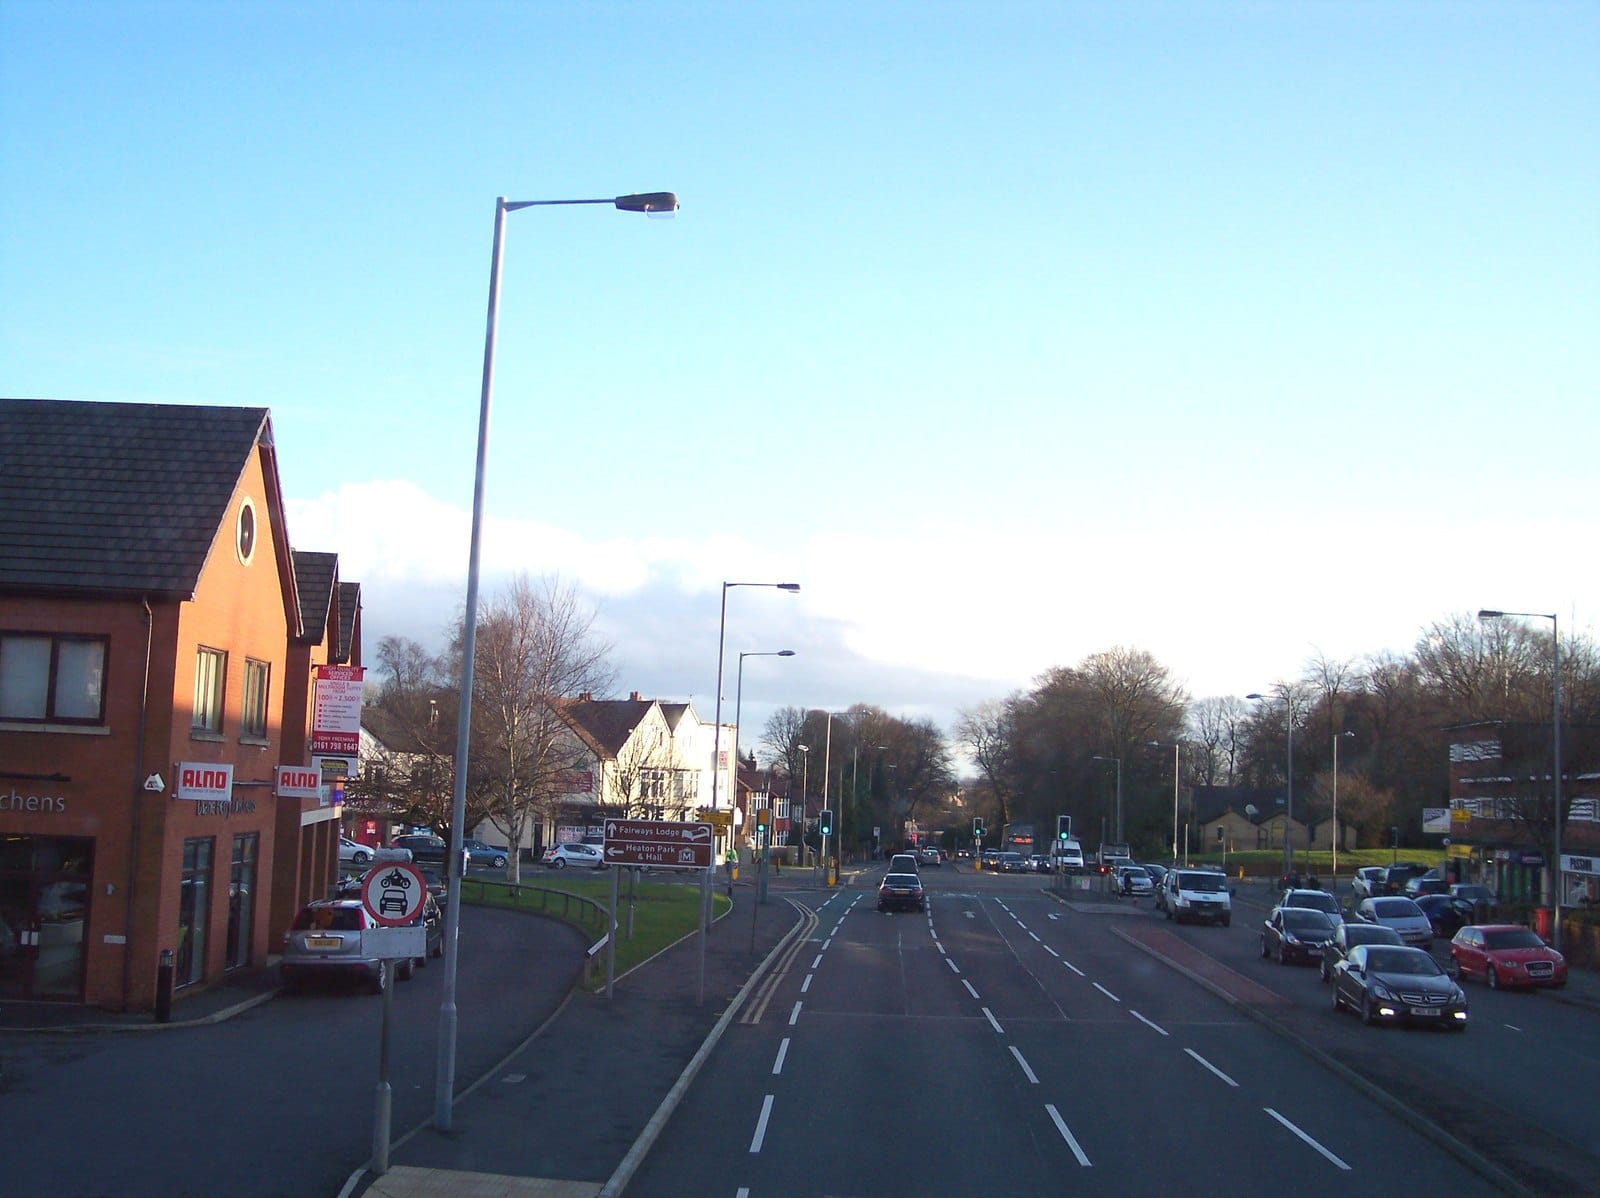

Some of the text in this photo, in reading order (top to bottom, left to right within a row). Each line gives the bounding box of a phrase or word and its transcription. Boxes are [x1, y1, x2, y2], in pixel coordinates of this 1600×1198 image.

[313, 741, 328, 749] 0161
[343, 743, 358, 751] 1647
[182, 769, 227, 789] ALNO
[281, 772, 318, 788] ALNO
[0, 788, 65, 813] chens
[619, 826, 680, 836] Fairways Lodge
[625, 844, 676, 853] Heaton Park
